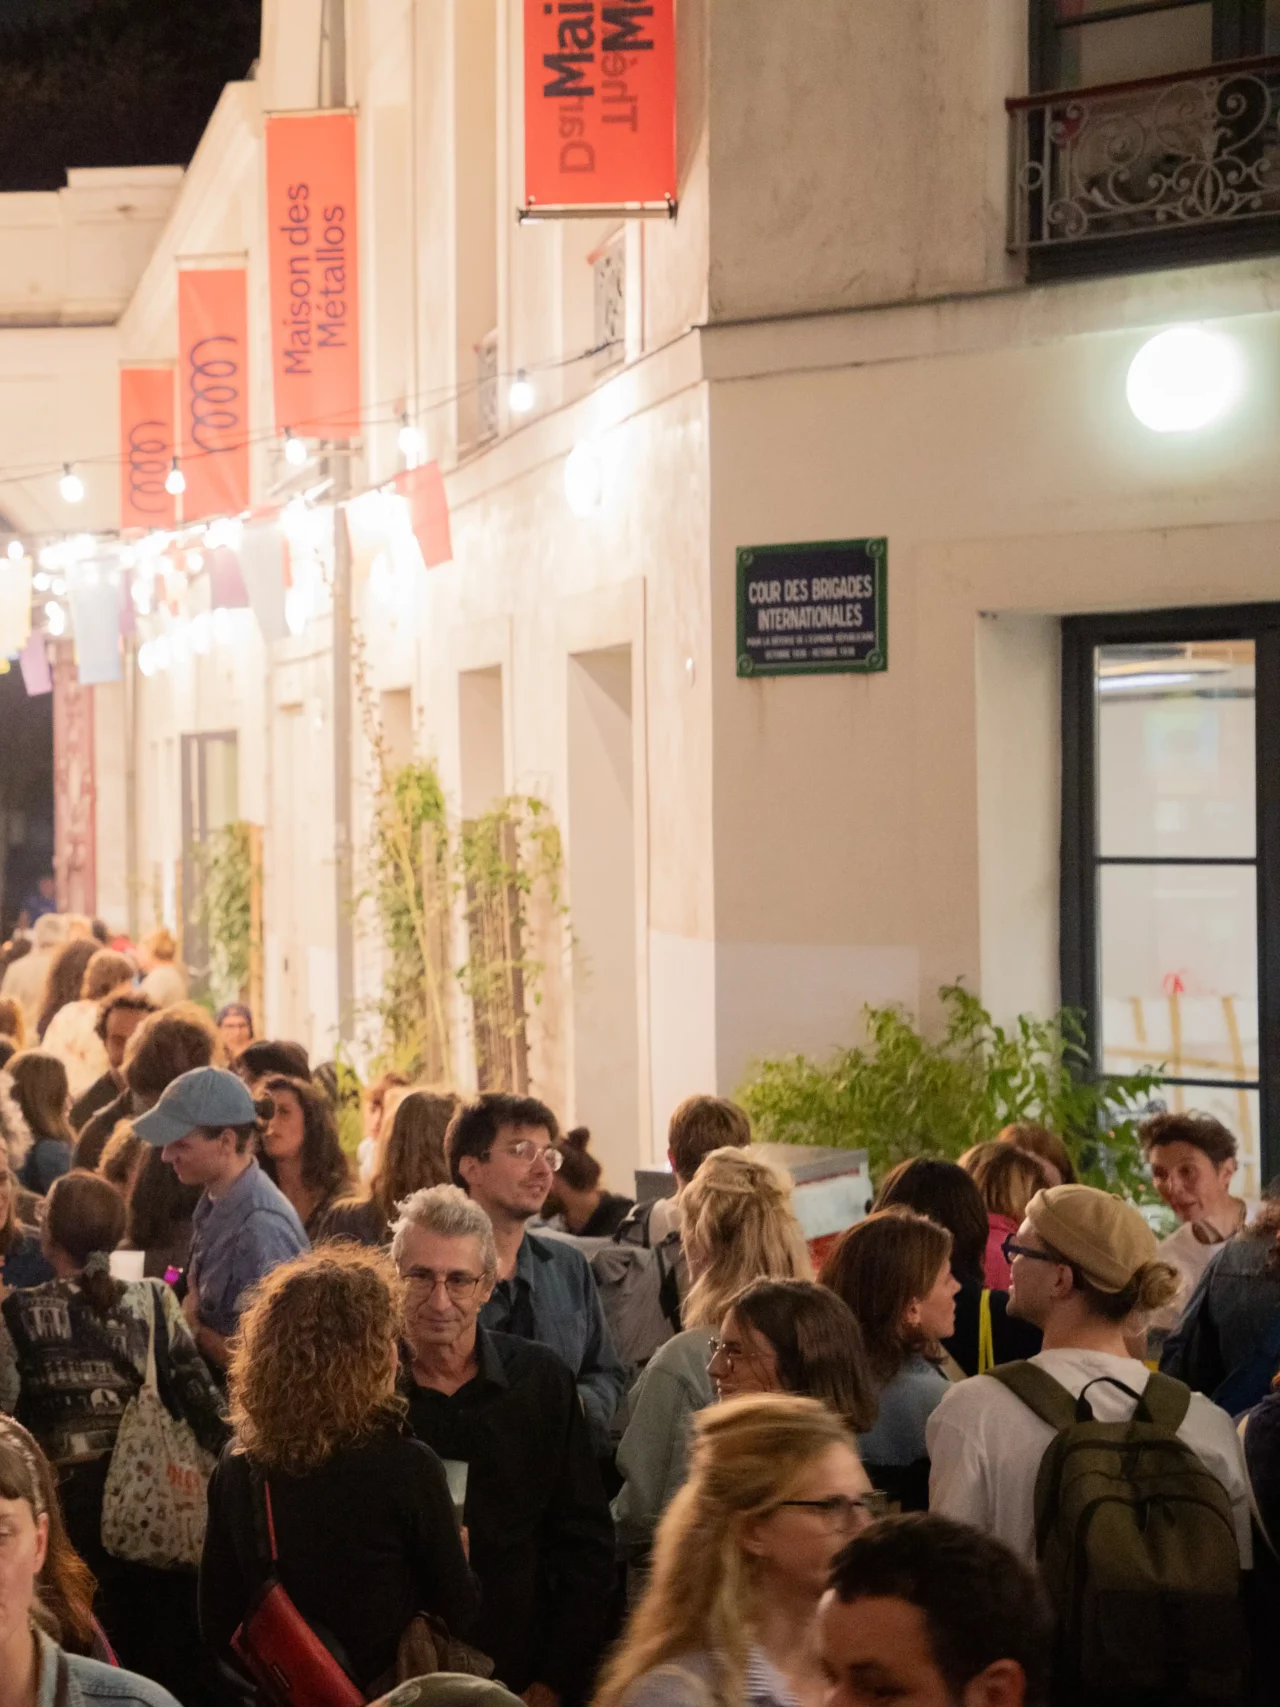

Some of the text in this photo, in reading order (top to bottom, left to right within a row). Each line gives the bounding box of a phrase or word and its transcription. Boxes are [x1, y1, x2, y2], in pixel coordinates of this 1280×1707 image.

[601, 0, 655, 52] M
[280, 182, 313, 375] Maison des
[316, 204, 346, 349] Métallos
[748, 574, 873, 604] COUR DES BRIGADES
[757, 603, 863, 631] INTERNATIONALES
